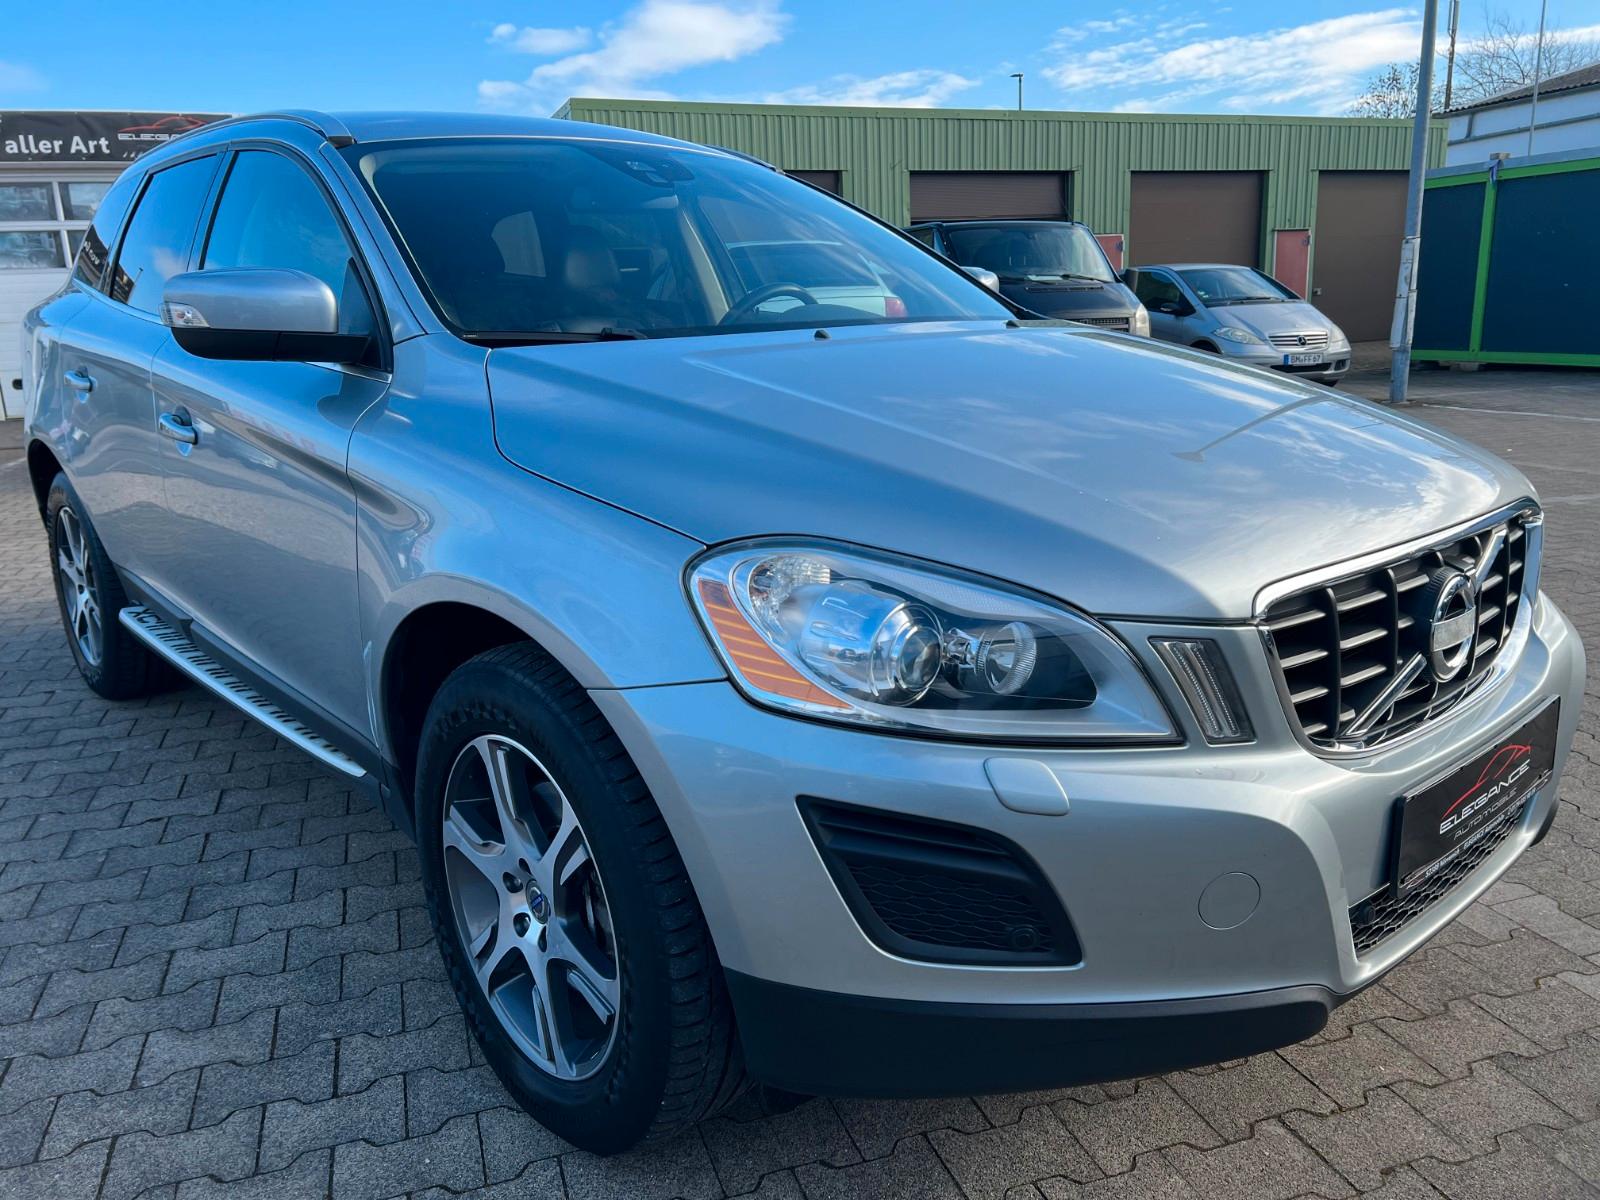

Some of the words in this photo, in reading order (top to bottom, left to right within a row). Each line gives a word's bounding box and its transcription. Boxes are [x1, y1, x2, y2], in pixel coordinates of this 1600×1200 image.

[5, 134, 63, 154] aller
[70, 135, 111, 154] Art
[1440, 758, 1531, 835] ELEGANCE
